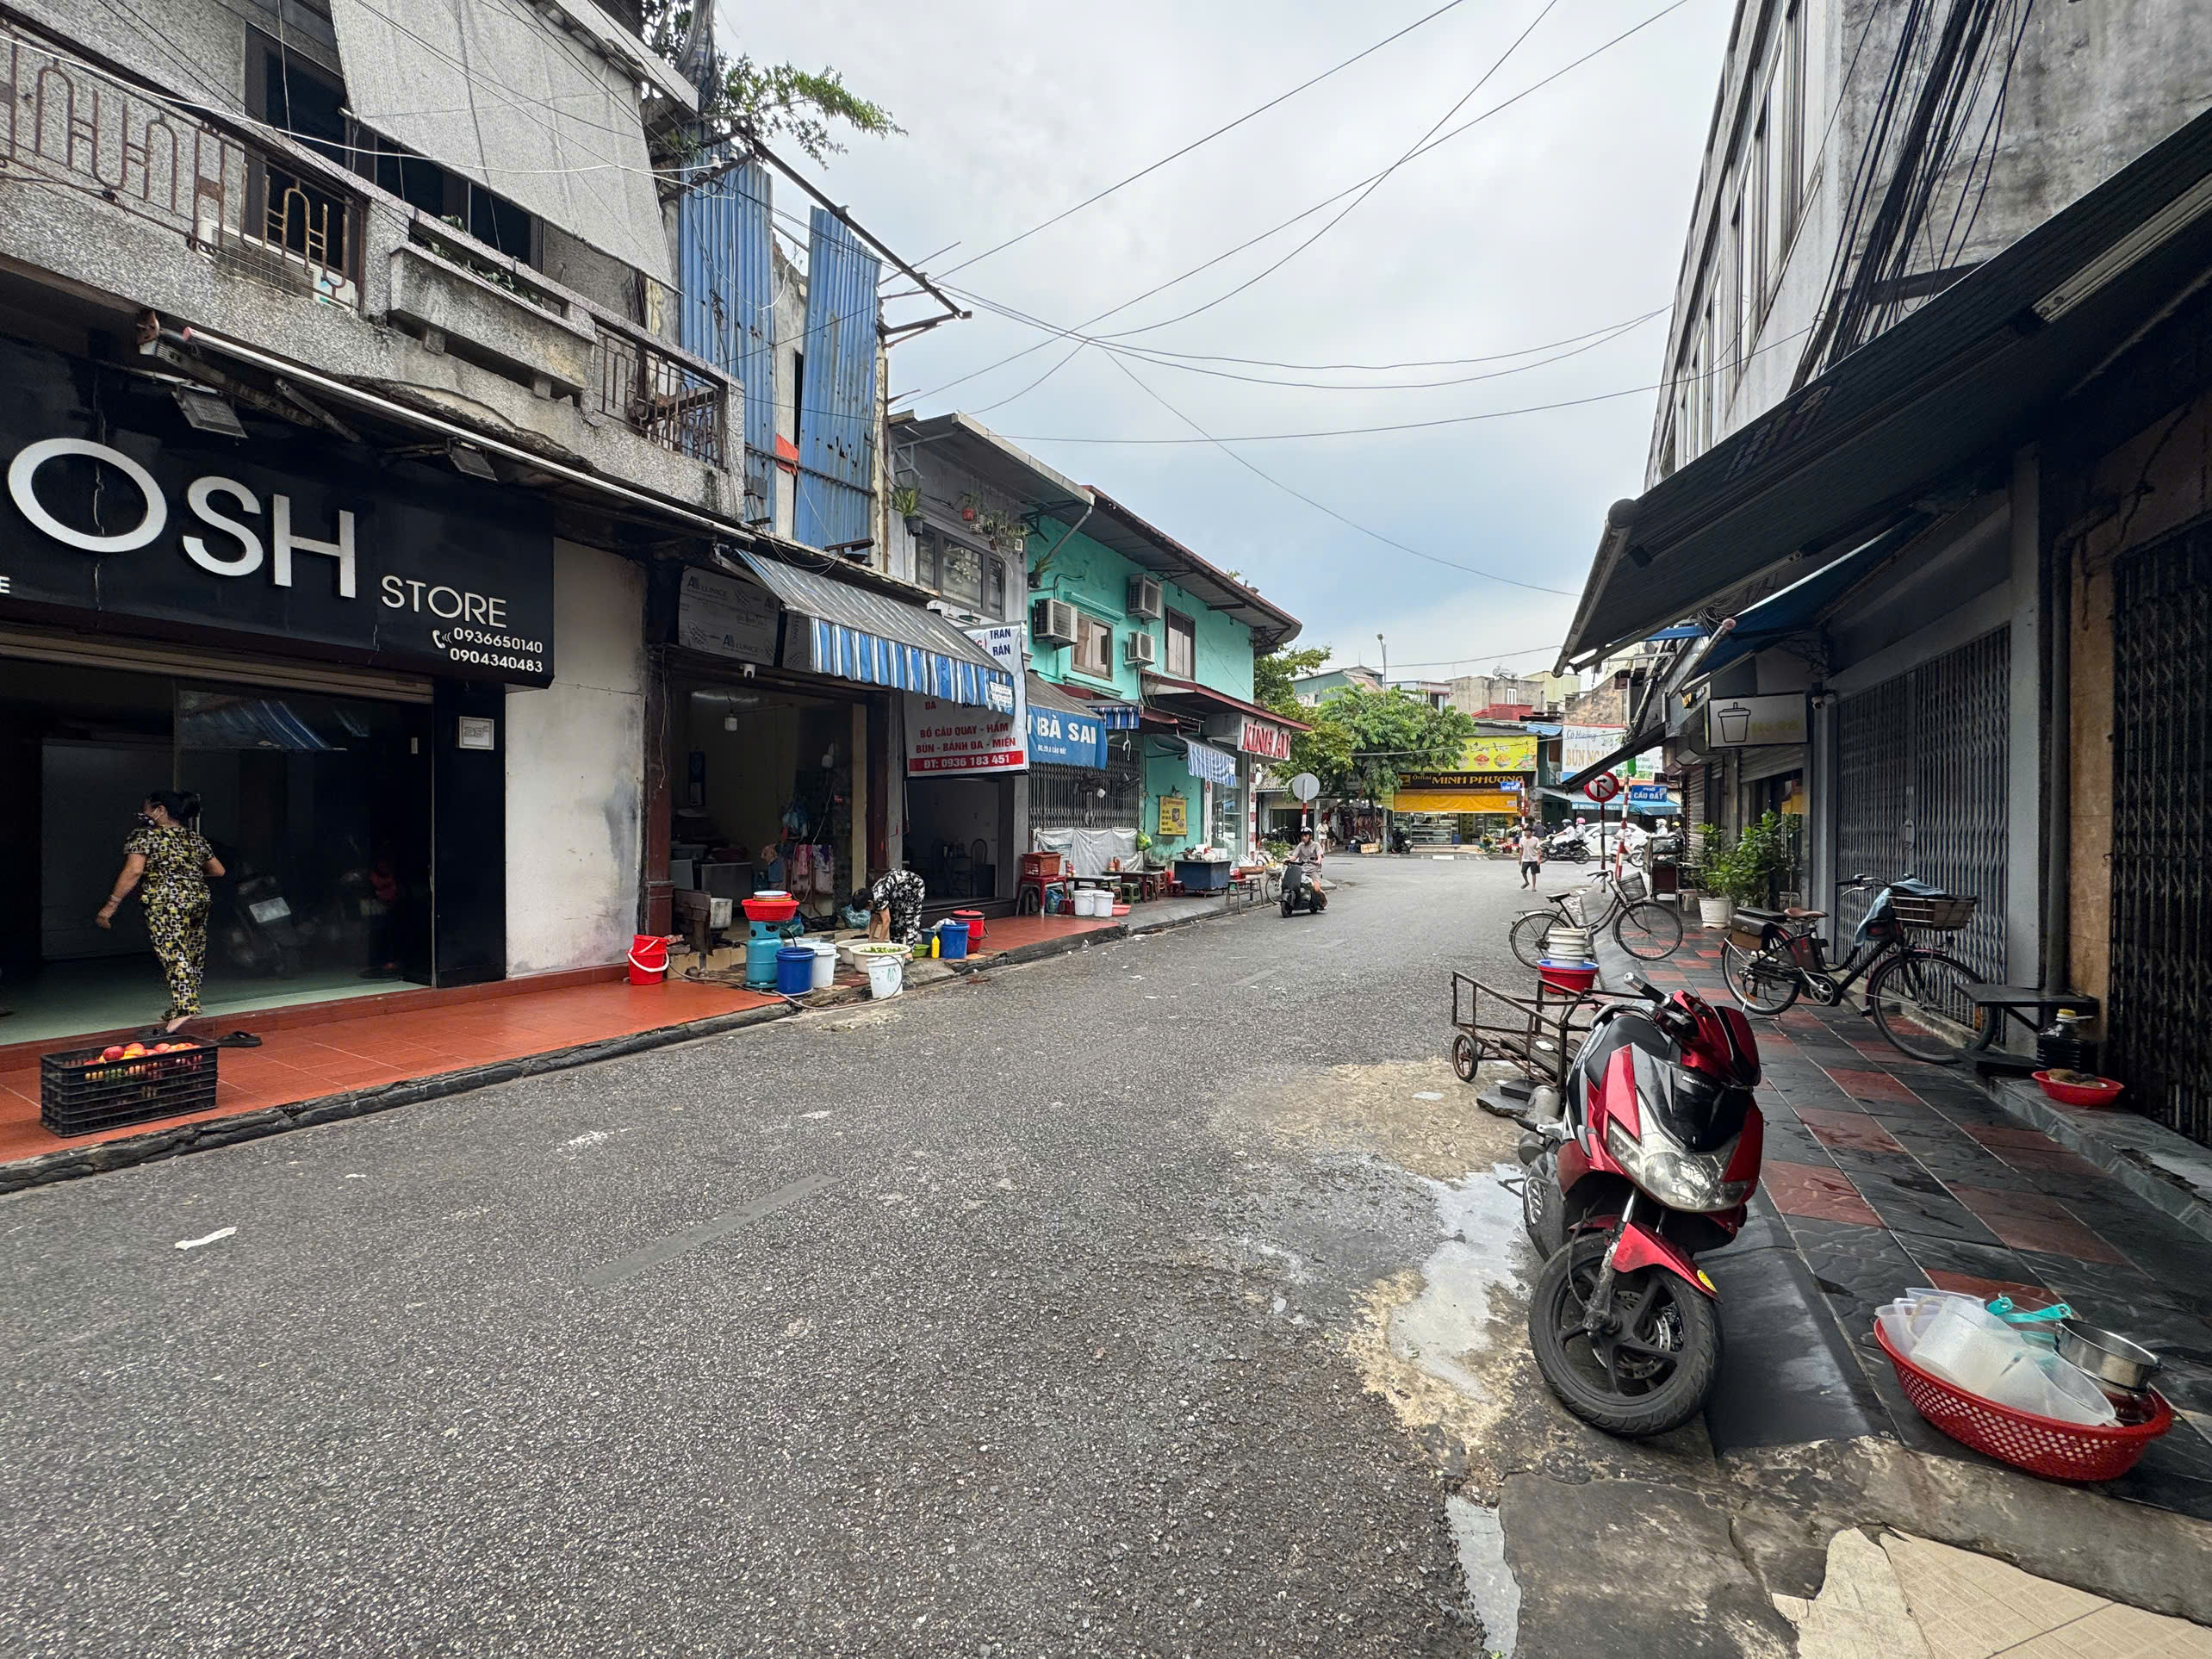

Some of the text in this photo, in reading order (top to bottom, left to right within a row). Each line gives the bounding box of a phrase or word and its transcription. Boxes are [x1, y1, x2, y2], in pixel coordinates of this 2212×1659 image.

[382, 575, 506, 628] STORE
[453, 627, 543, 654] 0936650140
[450, 648, 543, 672] 0904340483
[954, 725, 977, 736] QUAY
[1037, 714, 1061, 739] BÀ
[942, 741, 968, 752] BÁNH
[970, 741, 984, 750] ĐA
[1242, 719, 1275, 755] KÍNH
[923, 754, 1010, 769] ĐT: 0936 183 451
[1432, 776, 1467, 785] MINH
[1633, 790, 1648, 799] CẦU
